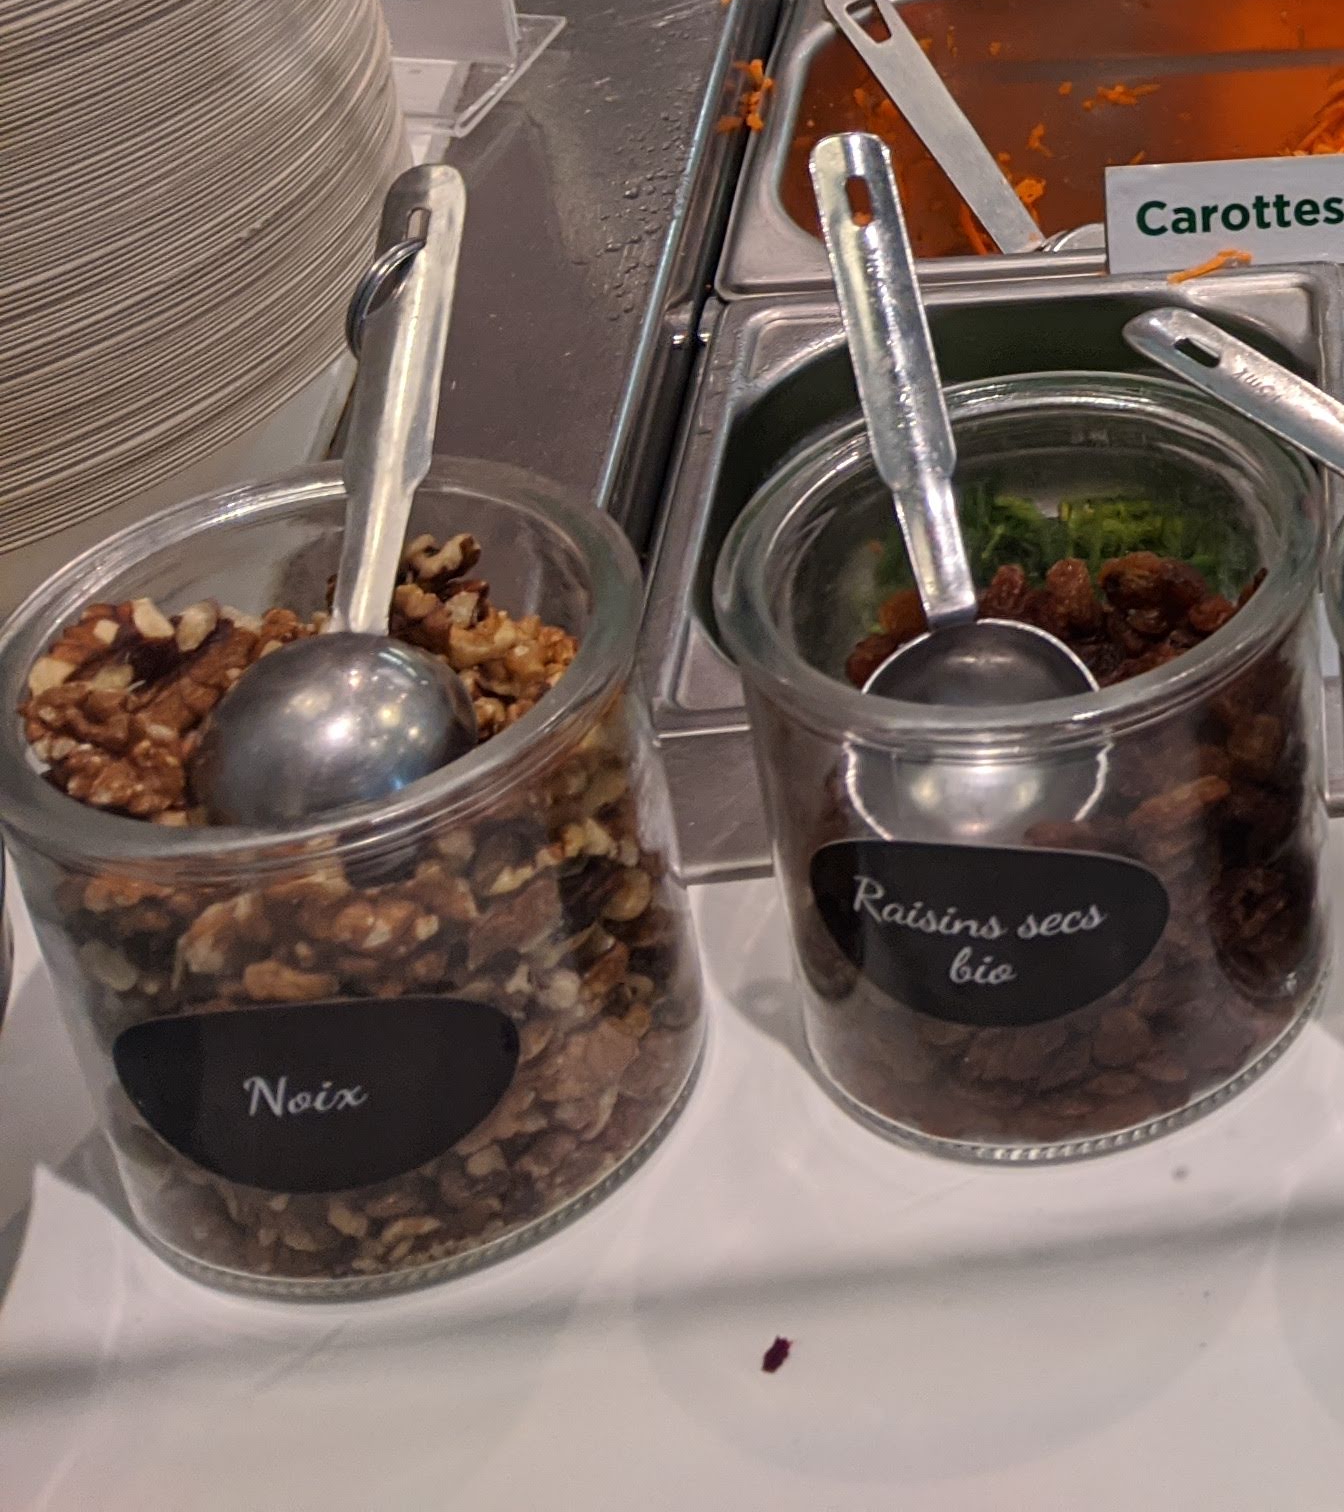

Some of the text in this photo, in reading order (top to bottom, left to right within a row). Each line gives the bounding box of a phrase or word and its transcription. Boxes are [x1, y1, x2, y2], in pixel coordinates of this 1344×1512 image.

[853, 874, 1109, 940] Raisins secs
[949, 945, 1017, 986] bio
[243, 1075, 369, 1118] Noix
